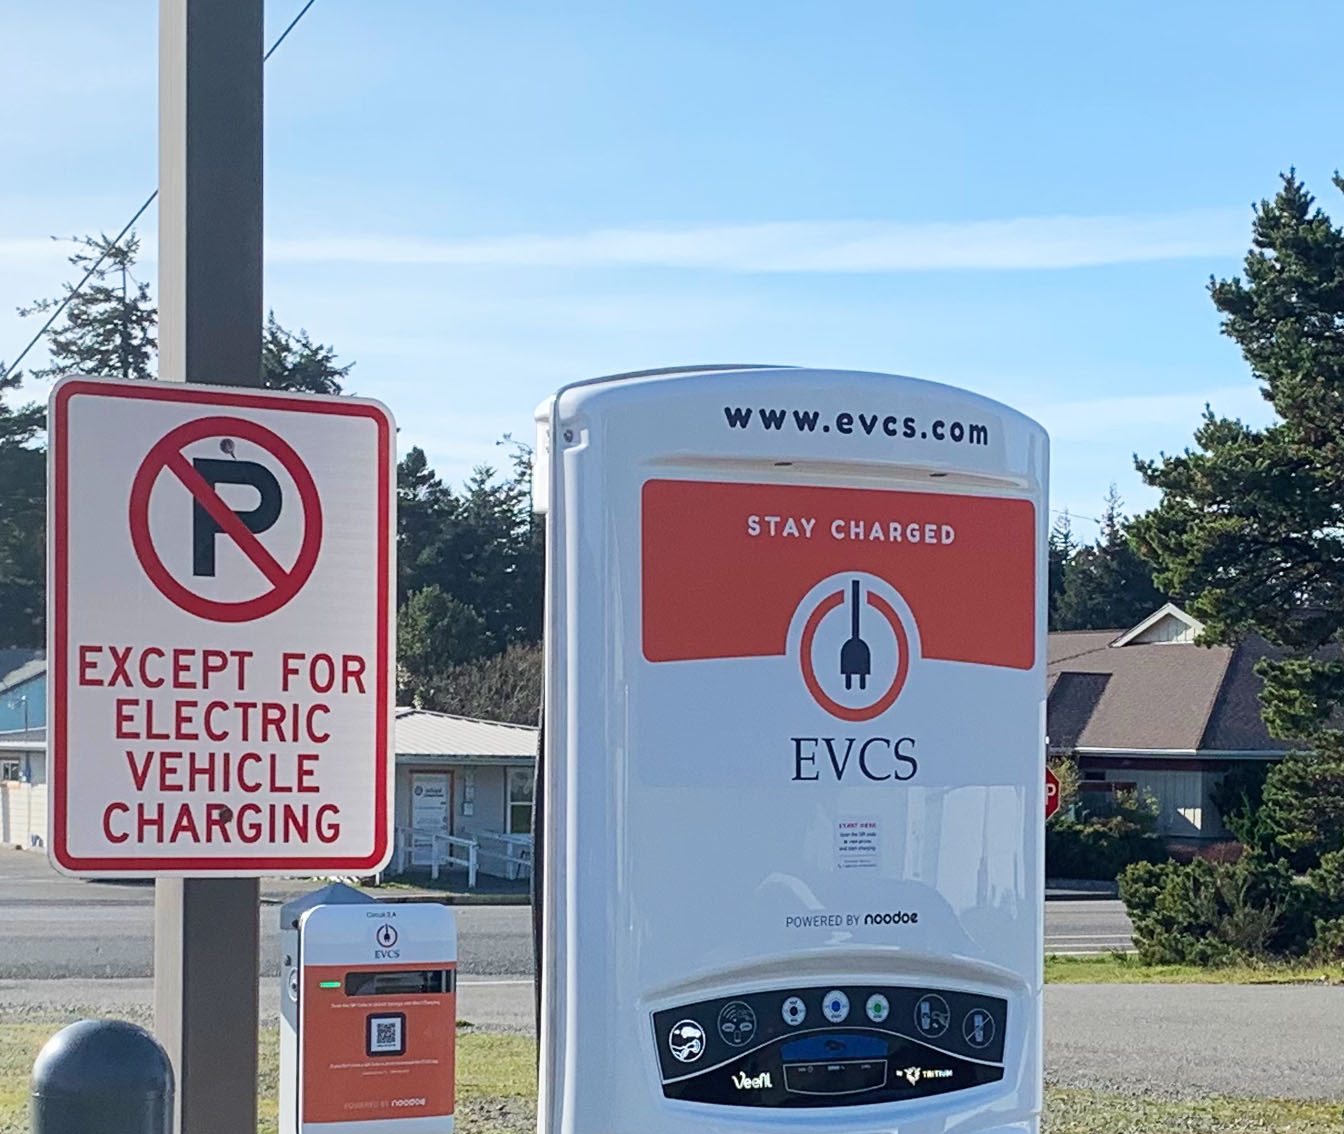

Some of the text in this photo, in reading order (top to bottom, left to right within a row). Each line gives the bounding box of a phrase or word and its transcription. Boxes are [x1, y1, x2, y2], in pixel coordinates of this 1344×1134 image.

[724, 406, 989, 446] www.evcs.com
[747, 516, 955, 545] STAY CHARGED
[78, 645, 366, 694] EXCEPT FOR
[116, 699, 331, 743] ELECTRIC
[126, 751, 320, 793] VEHICLE
[790, 738, 918, 782] EVCS
[103, 802, 340, 844] CHARGING
[786, 910, 919, 928] POWERED BY noodoe
[375, 949, 400, 959] EVCS
